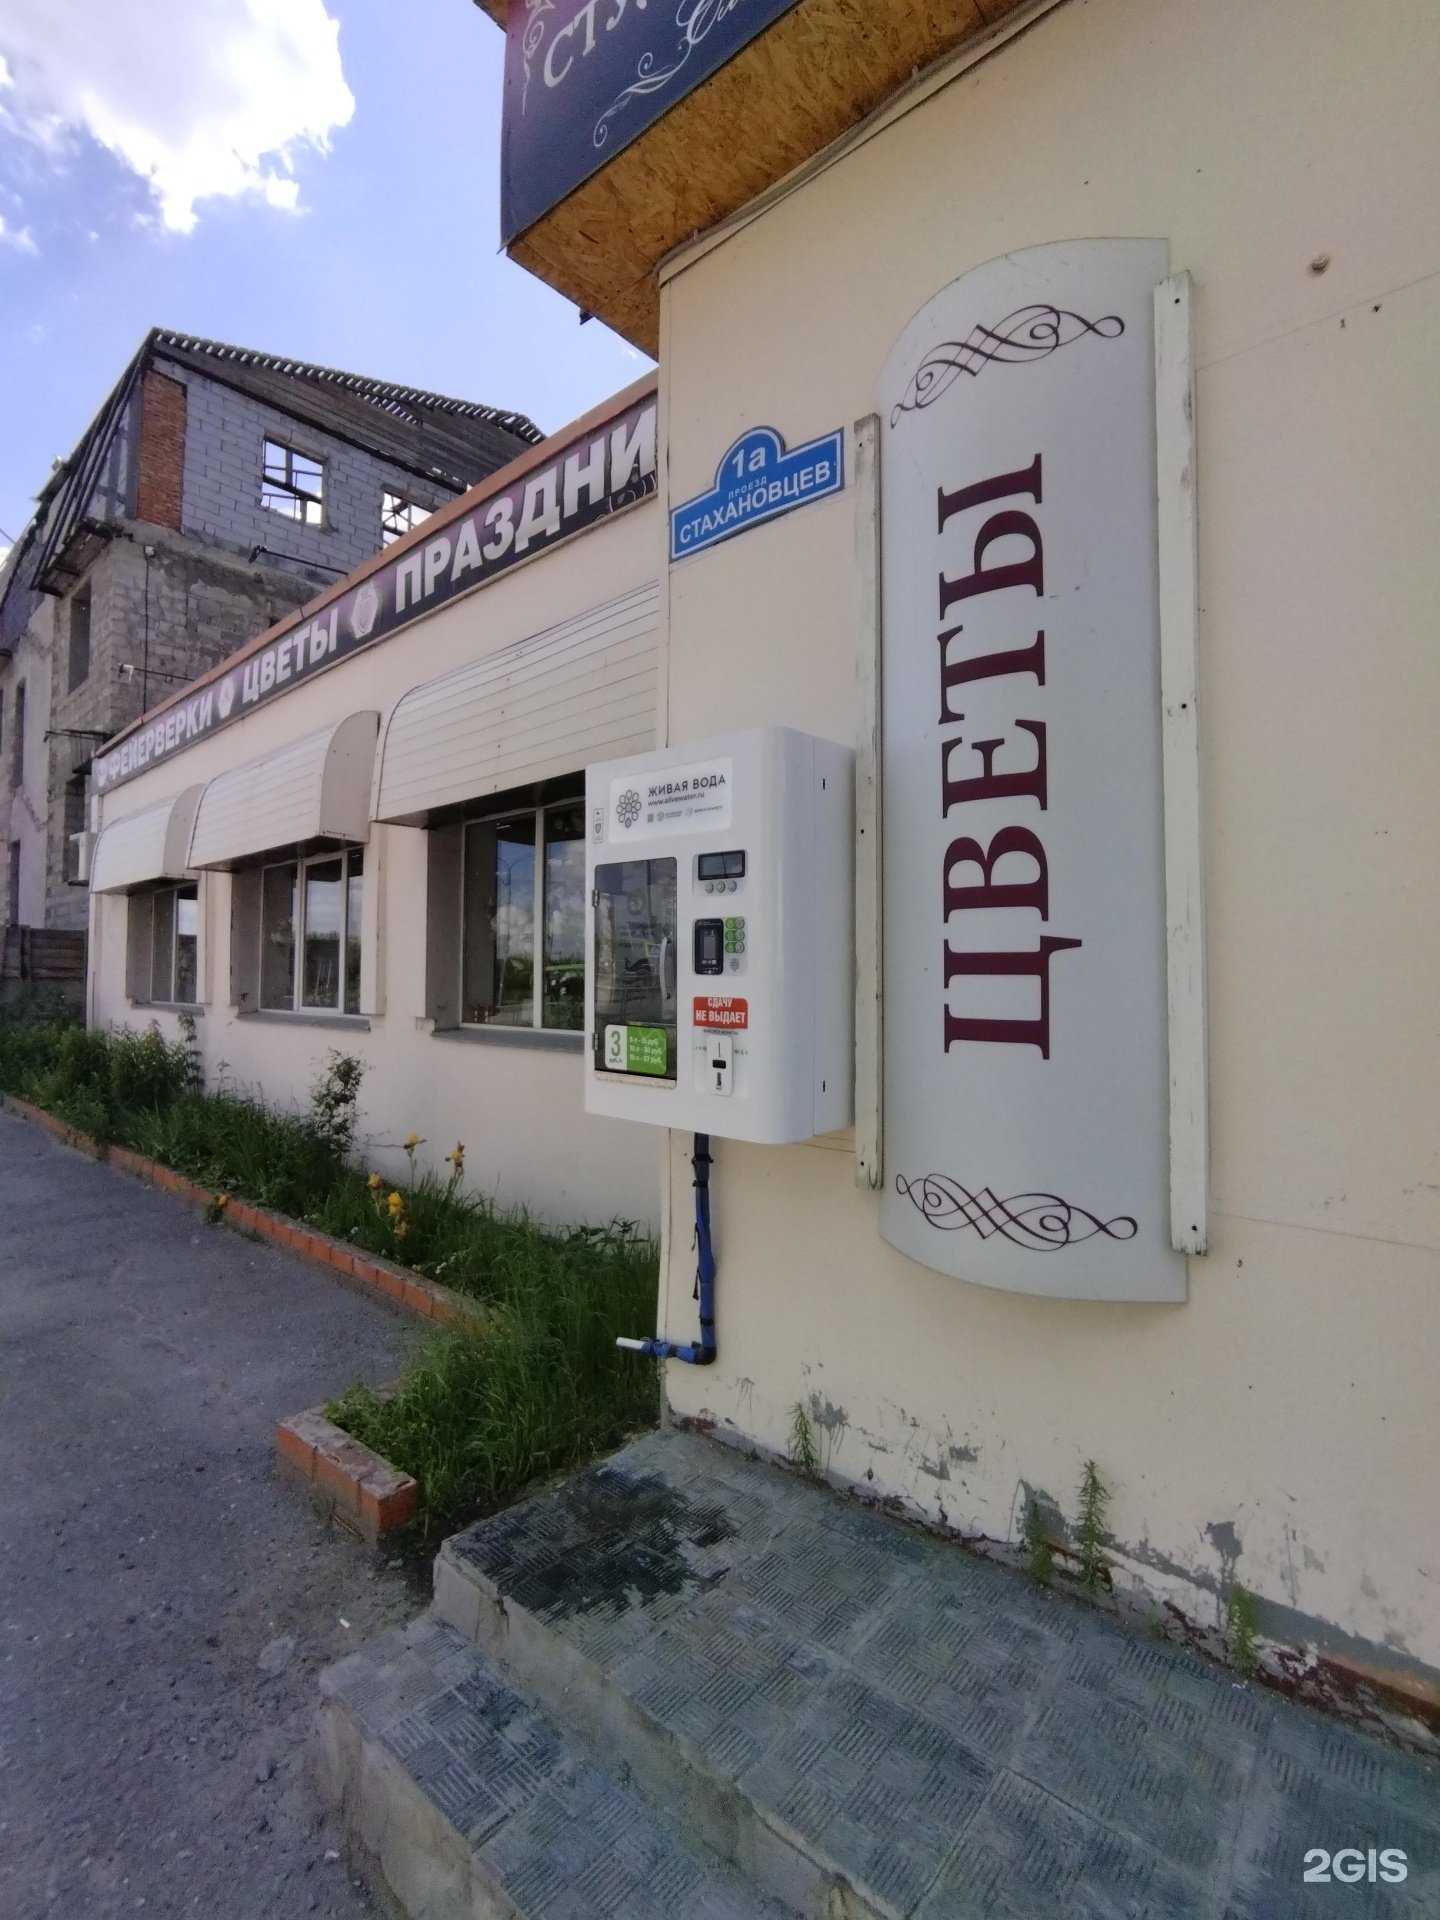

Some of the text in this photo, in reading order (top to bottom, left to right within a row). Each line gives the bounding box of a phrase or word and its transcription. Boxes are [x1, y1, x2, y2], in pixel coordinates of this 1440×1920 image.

[732, 446, 766, 479] 1а
[728, 475, 768, 502] ПРОЕЗД
[679, 461, 832, 545] СТАХАНОВЦЕВ
[240, 607, 339, 706] ЦВЕТЫ
[937, 453, 1083, 1061] ЦВЕТЫ
[648, 774, 726, 797] ЖИВАЯ ВОДА
[707, 997, 733, 1009] СДАЧУ
[695, 1009, 746, 1025] НЕ ВЫДАЕТ
[610, 1030, 621, 1057] 3
